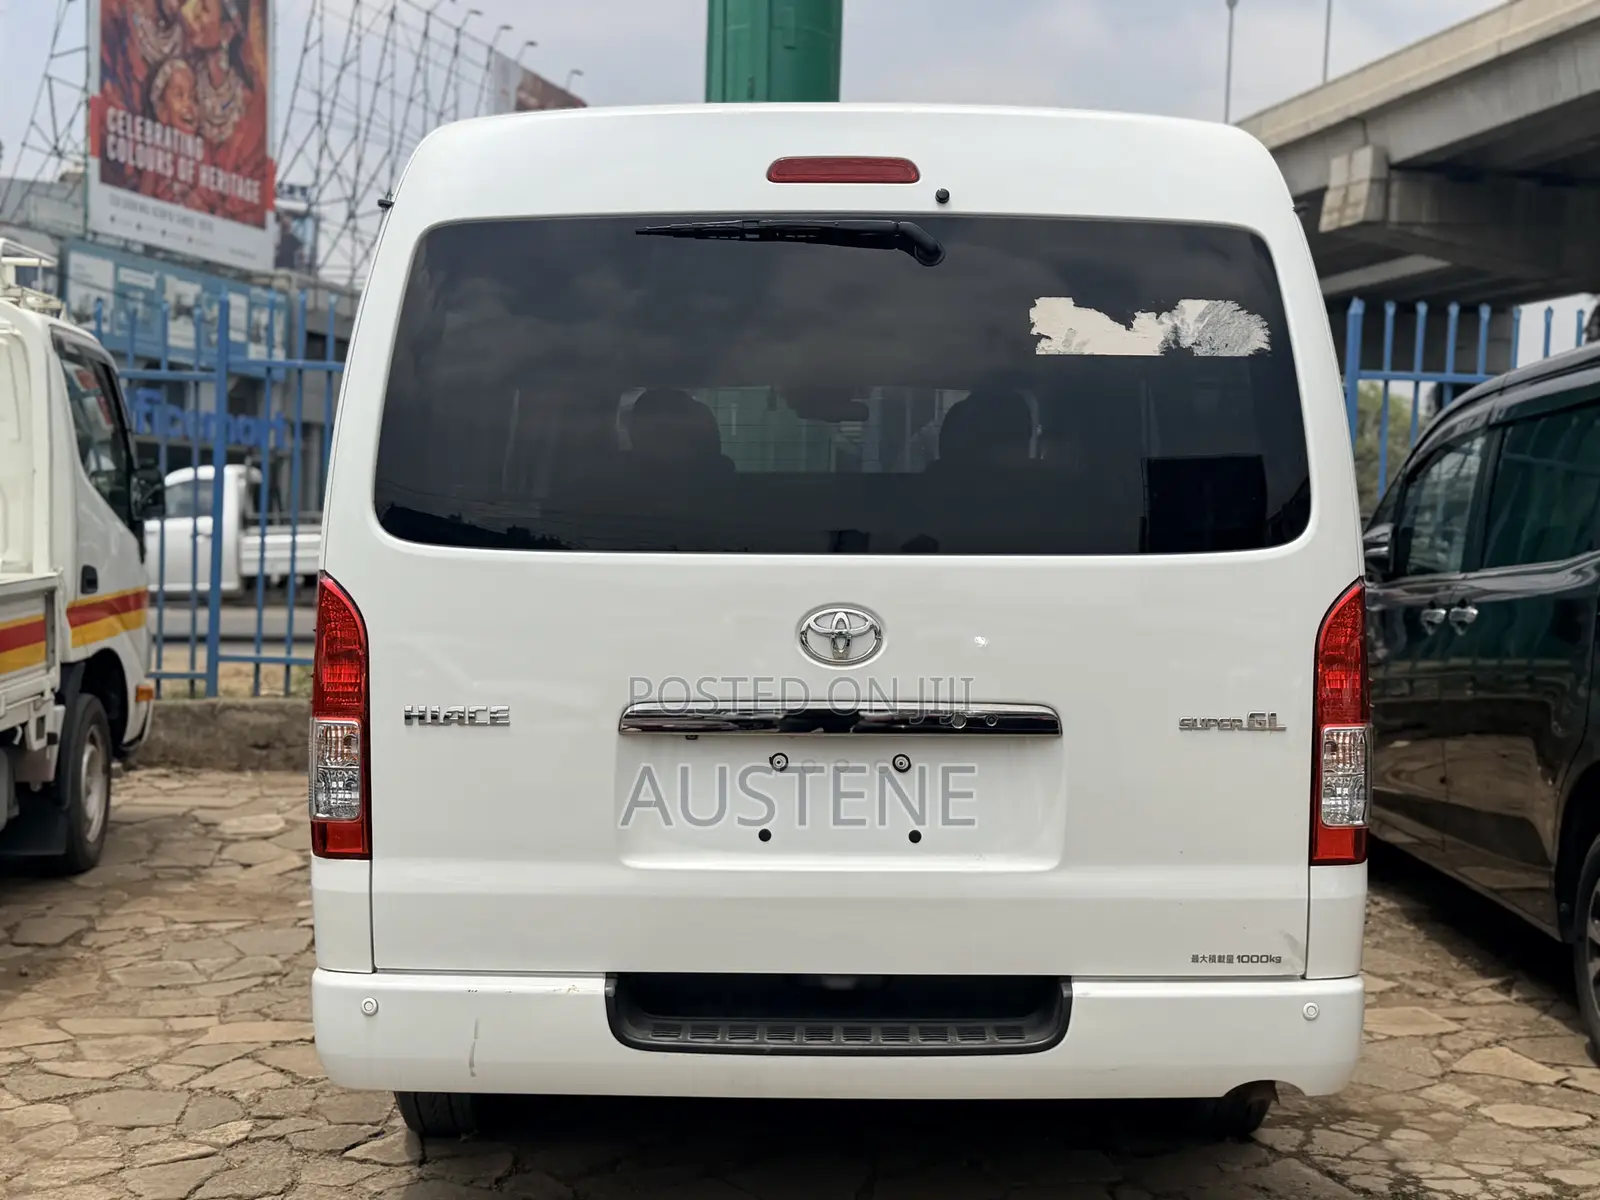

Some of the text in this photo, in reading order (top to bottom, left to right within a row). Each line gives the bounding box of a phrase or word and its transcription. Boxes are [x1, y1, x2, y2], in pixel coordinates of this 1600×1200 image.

[106, 105, 204, 162] CELEBRATING
[106, 133, 261, 205] COLOURS OF HERITAGE
[404, 705, 510, 726] HIACE
[1178, 710, 1287, 732] SUPER GL
[1190, 954, 1282, 964] 最大積載量 1000kg
